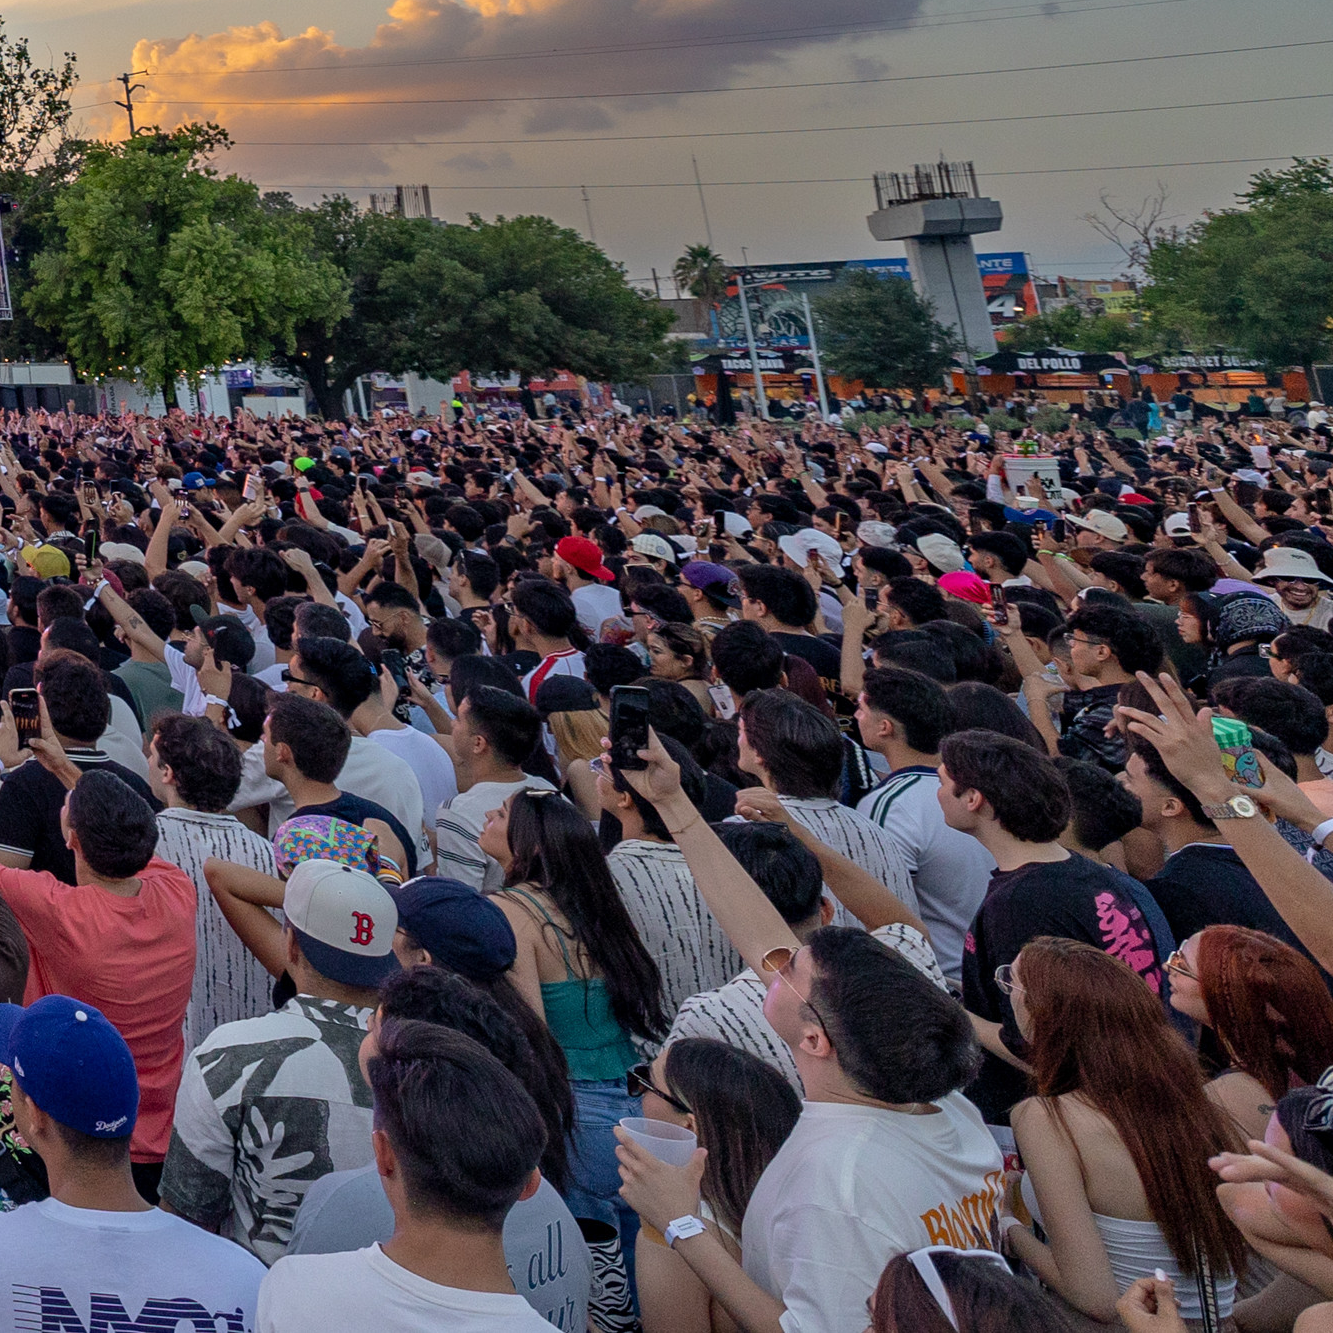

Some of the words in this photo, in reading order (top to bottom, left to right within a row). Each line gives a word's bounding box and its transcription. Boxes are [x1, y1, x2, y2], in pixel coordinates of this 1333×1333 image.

[720, 359, 752, 369] TACOS
[1017, 358, 1039, 370] DEL
[1042, 358, 1081, 370] POLLO
[350, 911, 375, 946] B
